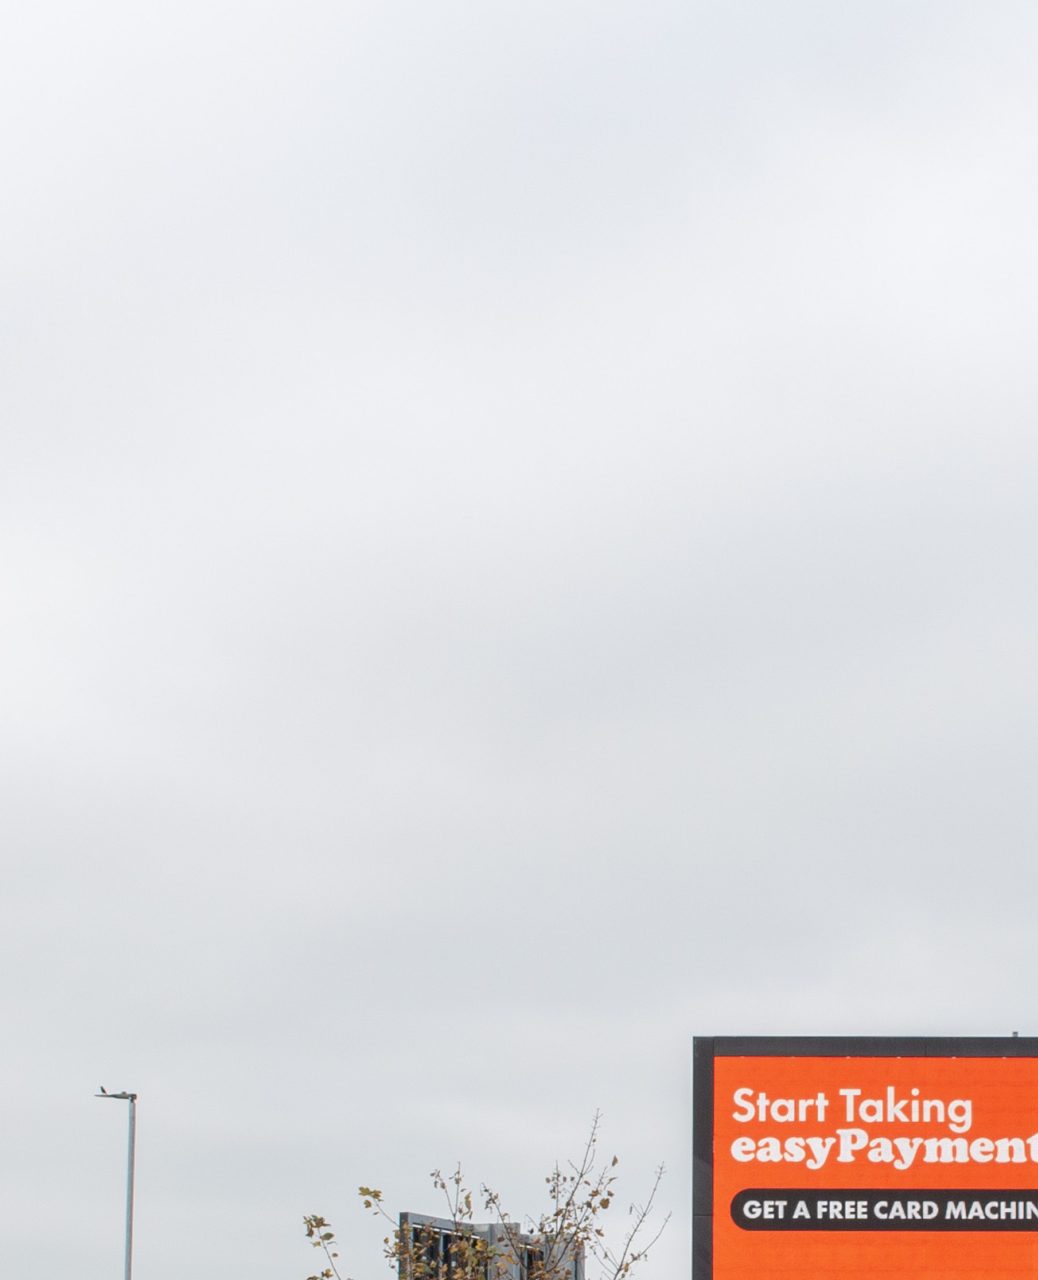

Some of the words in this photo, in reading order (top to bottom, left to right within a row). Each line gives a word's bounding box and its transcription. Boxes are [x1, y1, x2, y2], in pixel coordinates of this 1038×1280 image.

[732, 1088, 829, 1123] Start
[839, 1086, 973, 1133] Taking
[743, 1200, 788, 1220] GET
[792, 1200, 811, 1220] A
[817, 1200, 868, 1220] FREE
[873, 1200, 939, 1220] CARD
